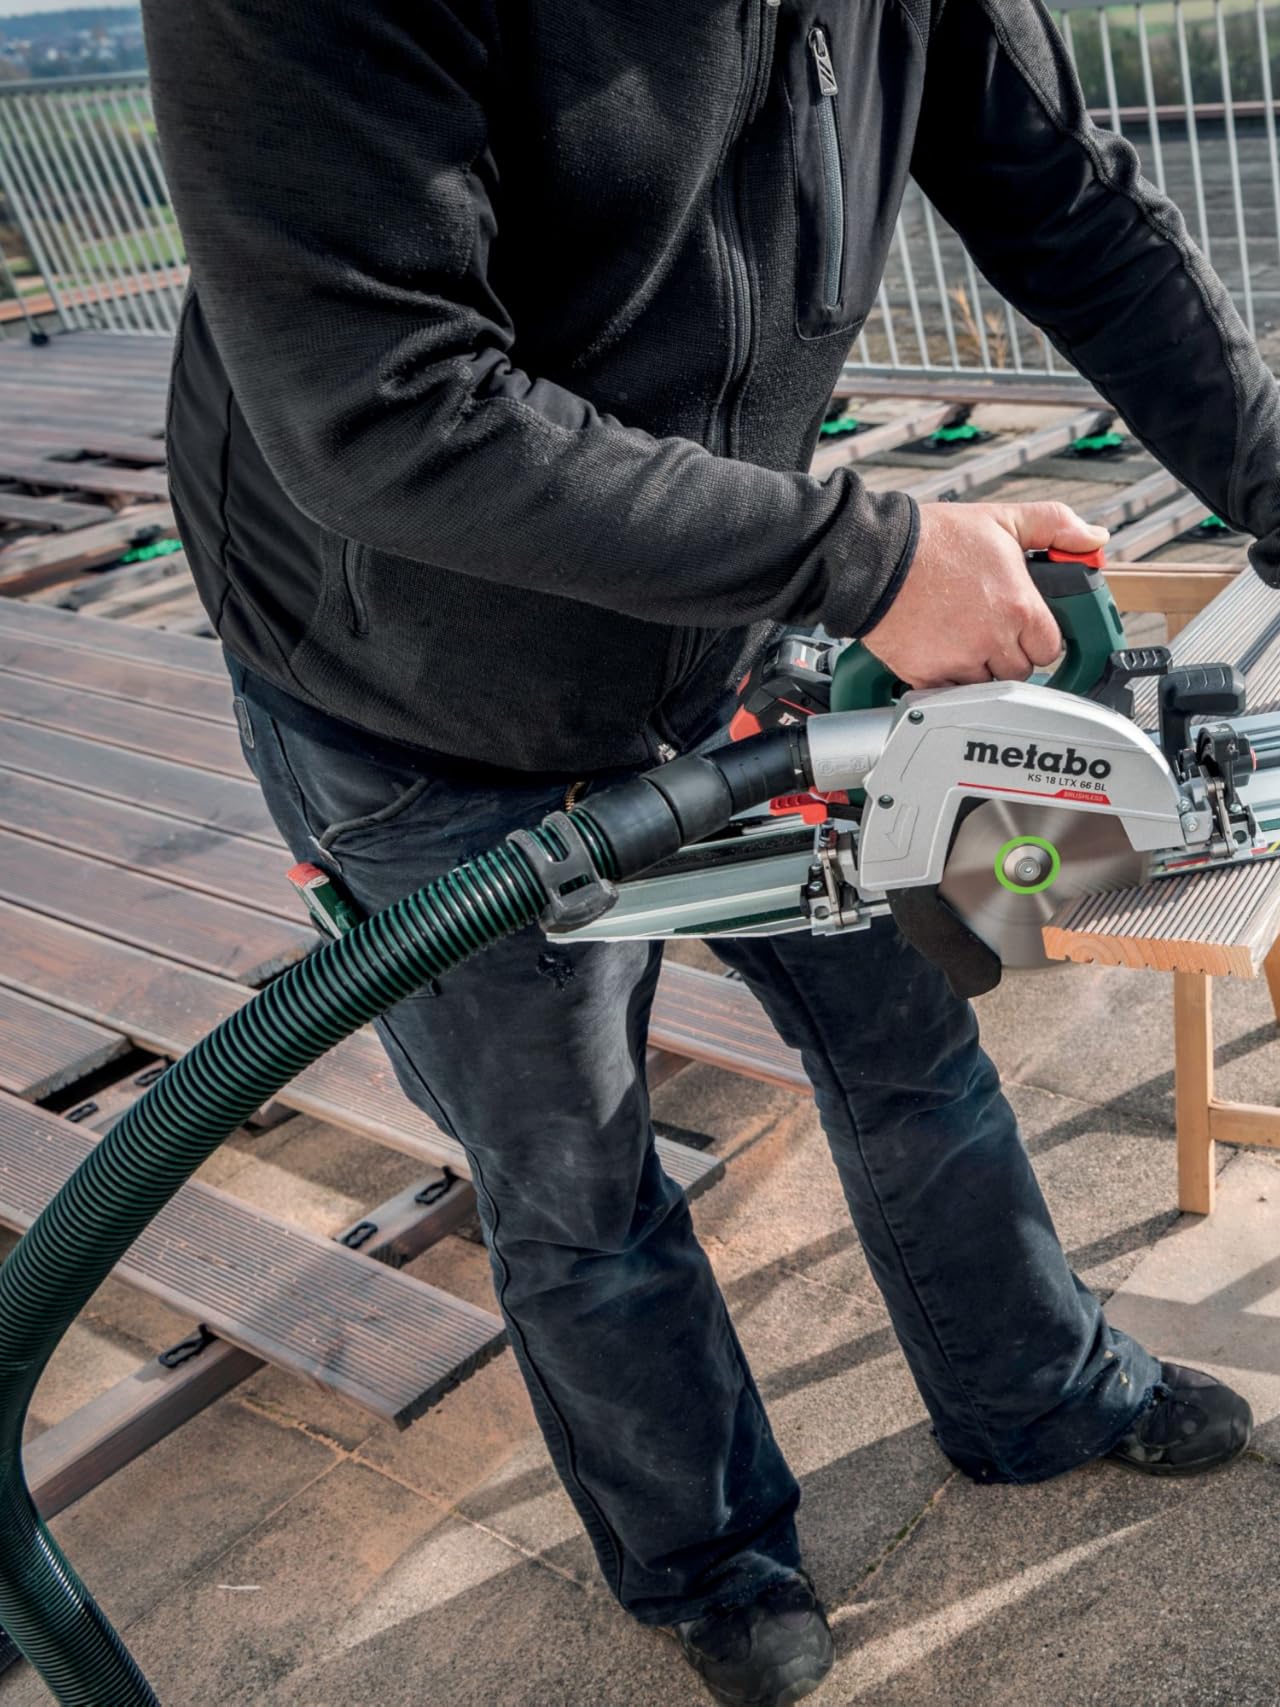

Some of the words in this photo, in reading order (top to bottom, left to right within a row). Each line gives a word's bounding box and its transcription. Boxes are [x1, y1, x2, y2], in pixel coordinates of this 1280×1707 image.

[964, 741, 1111, 779] metabo
[1027, 773, 1042, 782] KS
[1045, 775, 1056, 785] 18
[1059, 777, 1076, 787] LTX
[1080, 780, 1092, 789] 66
[1094, 782, 1107, 791] BL
